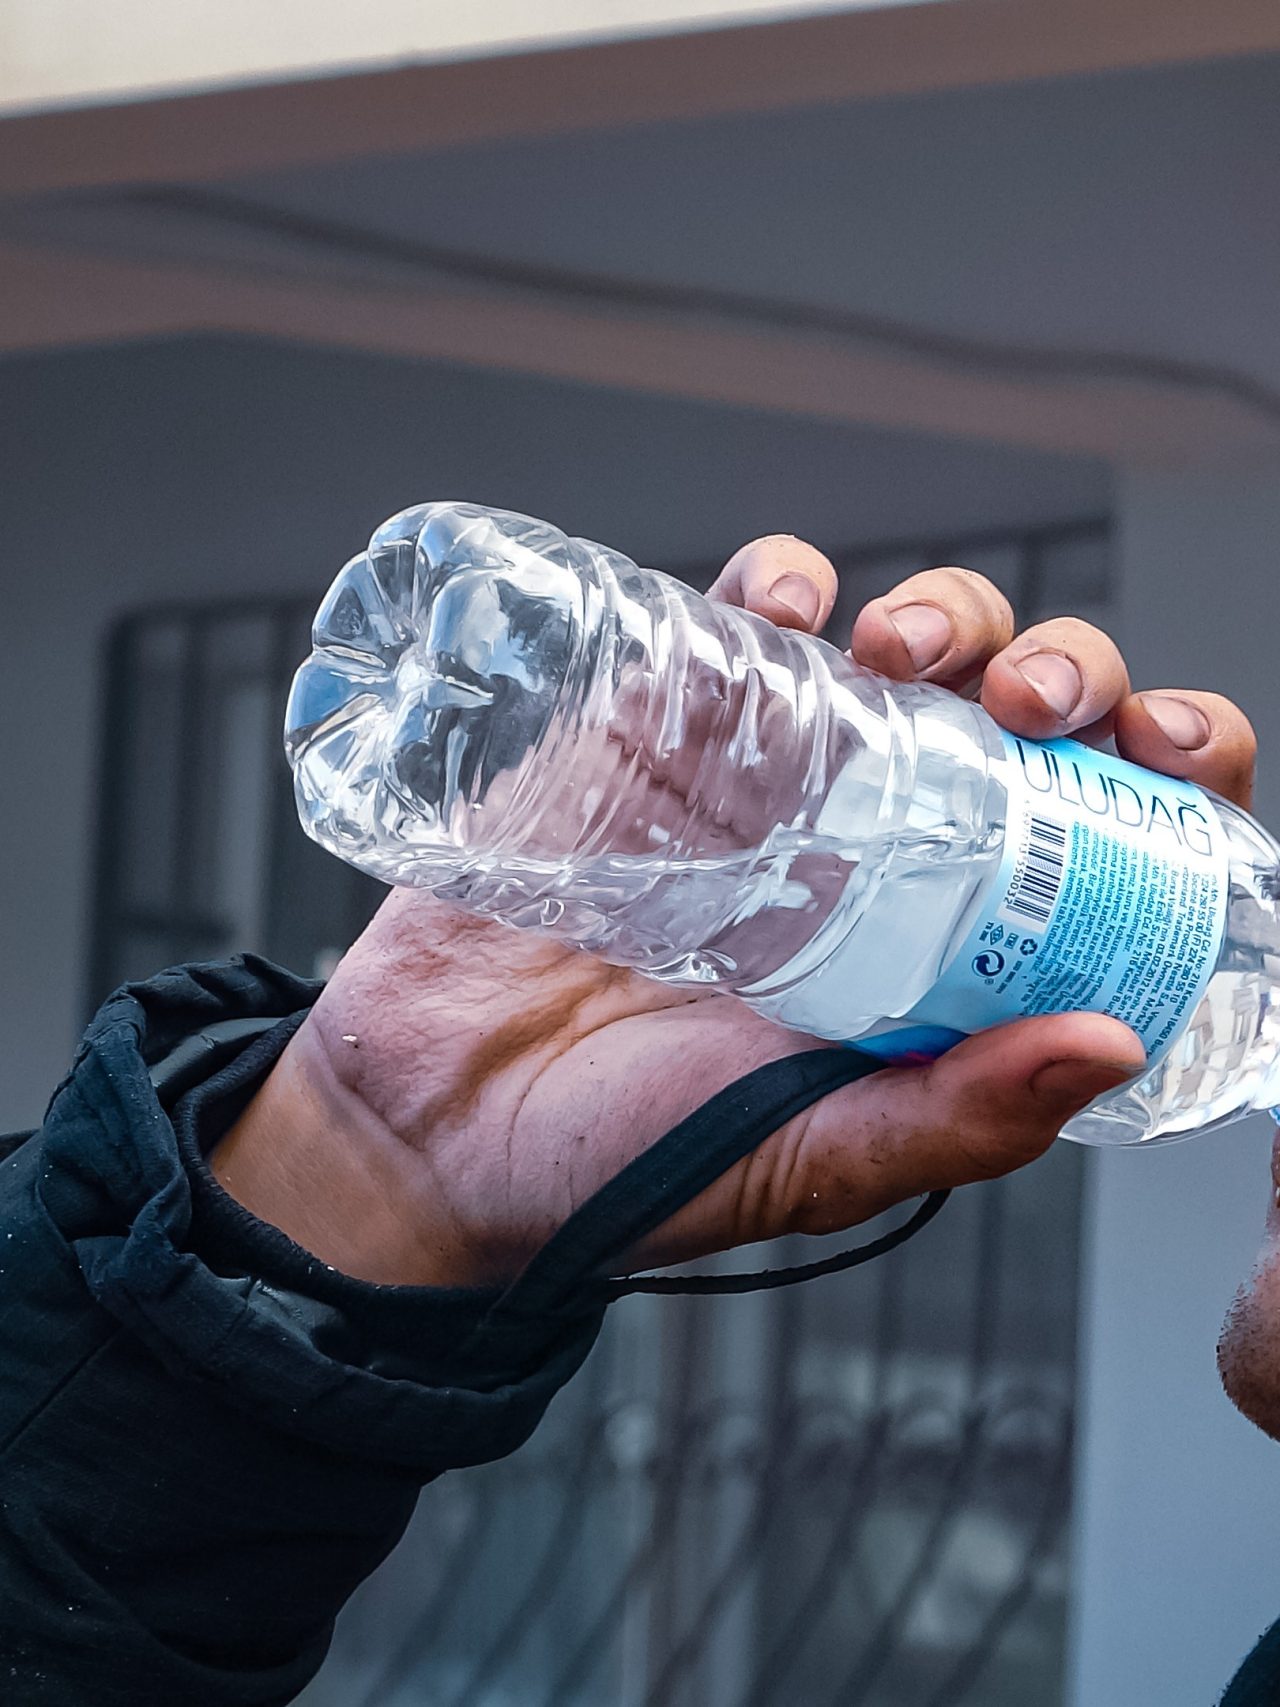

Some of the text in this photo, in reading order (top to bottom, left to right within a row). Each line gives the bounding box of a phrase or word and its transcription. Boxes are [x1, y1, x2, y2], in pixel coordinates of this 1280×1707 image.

[1015, 739, 1213, 857] ULUDAĞ
[1002, 858, 1026, 905] 550032
[1061, 865, 1076, 905] işlemine
[1087, 872, 1097, 887] Bir
[1071, 876, 1084, 907] ozonla
[1122, 889, 1135, 911] kuru
[1078, 886, 1093, 918] günlük
[1096, 904, 1111, 931] kadar
[1119, 911, 1128, 923] ve
[1186, 905, 1196, 922] des
[1197, 909, 1206, 921] 55
[1066, 918, 1084, 948] üretim
[1149, 923, 1160, 937] Su
[1166, 910, 1186, 959] Trademark
[1194, 921, 1204, 933] 00
[1078, 935, 1087, 948] ve
[1079, 931, 1101, 972] tazeliğini
[1105, 923, 1126, 961] kokusuz
[1145, 937, 1155, 949] ve
[1060, 949, 1073, 963] bir
[1070, 948, 1083, 966] seri
[1186, 946, 1198, 963] 224
[1100, 961, 1112, 974] bir
[1115, 966, 1134, 995] Kestel
[1174, 980, 1186, 992] 55
[1168, 992, 1180, 1004] 10
[1172, 989, 1193, 1017] Kestel
[1134, 996, 1156, 1024] Marka
